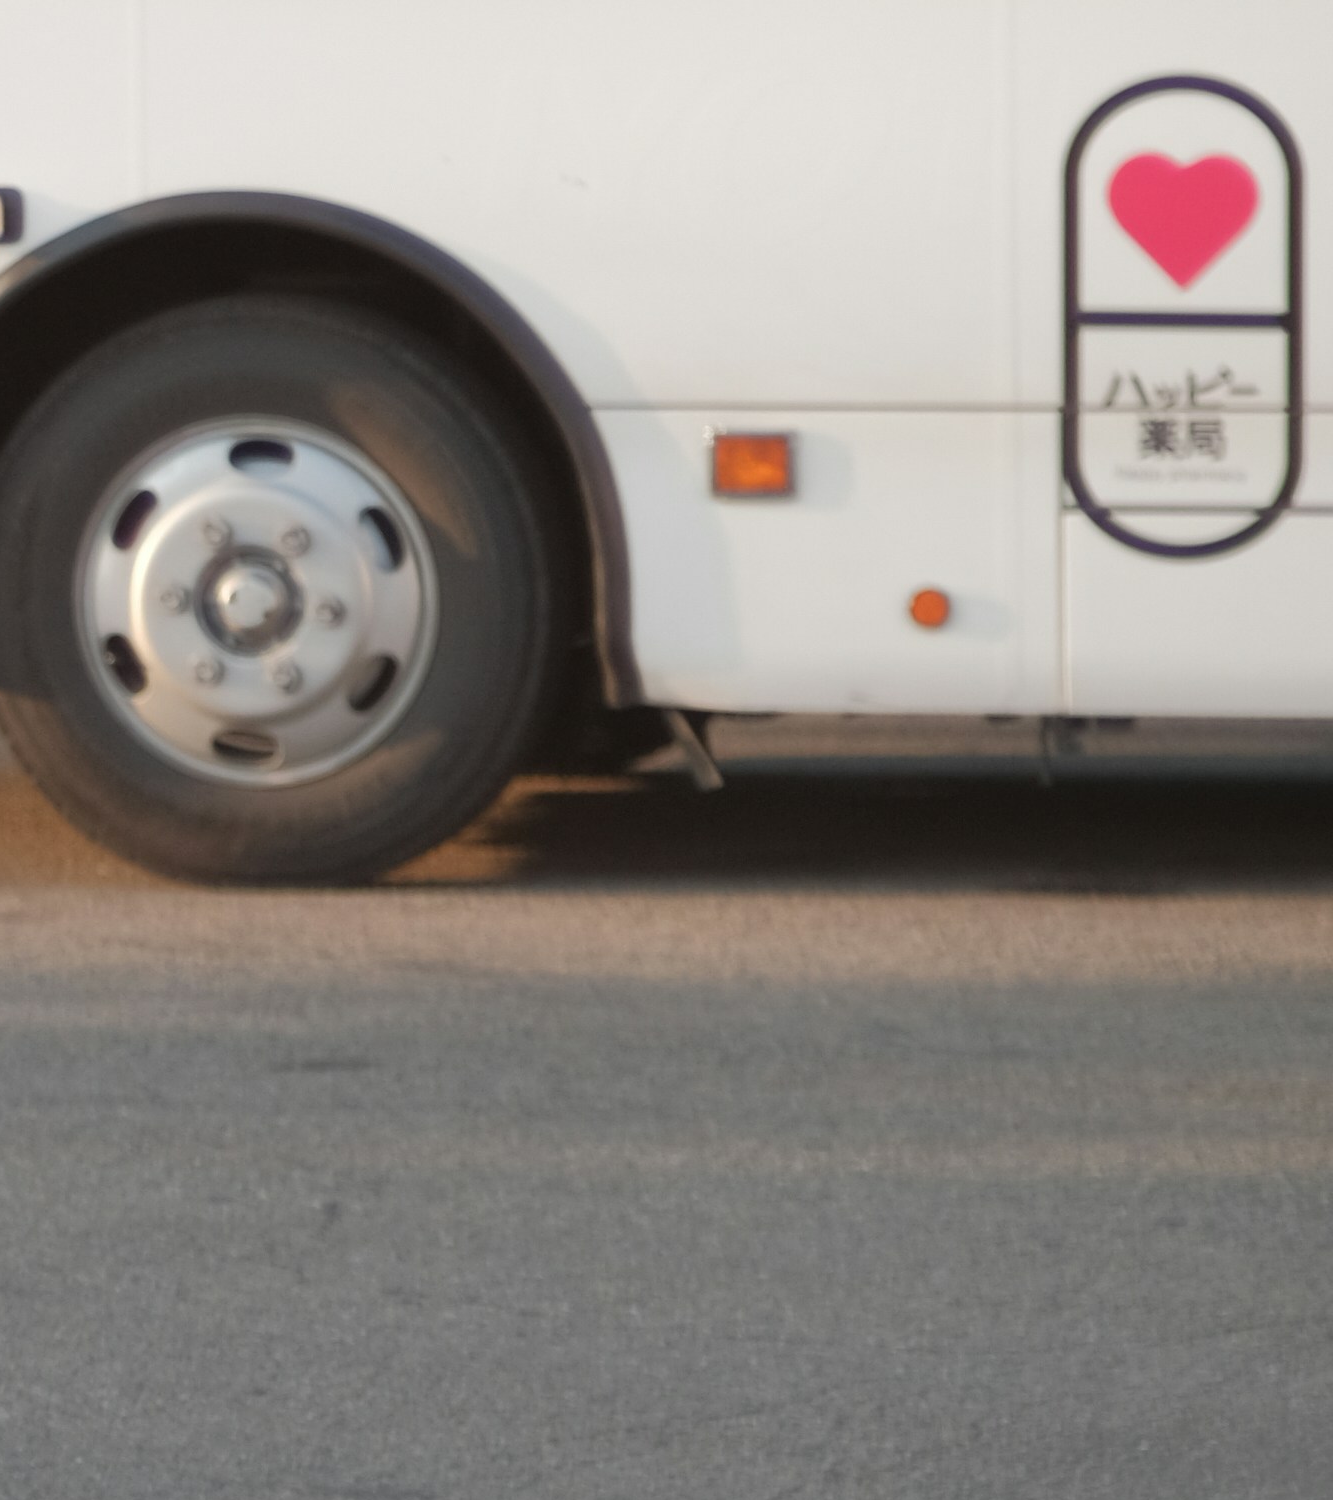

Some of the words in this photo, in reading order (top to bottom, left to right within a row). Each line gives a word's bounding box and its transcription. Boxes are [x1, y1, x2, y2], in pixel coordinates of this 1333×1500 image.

[1100, 364, 1261, 411] ハッピー
[1139, 417, 1227, 462] 薬局
